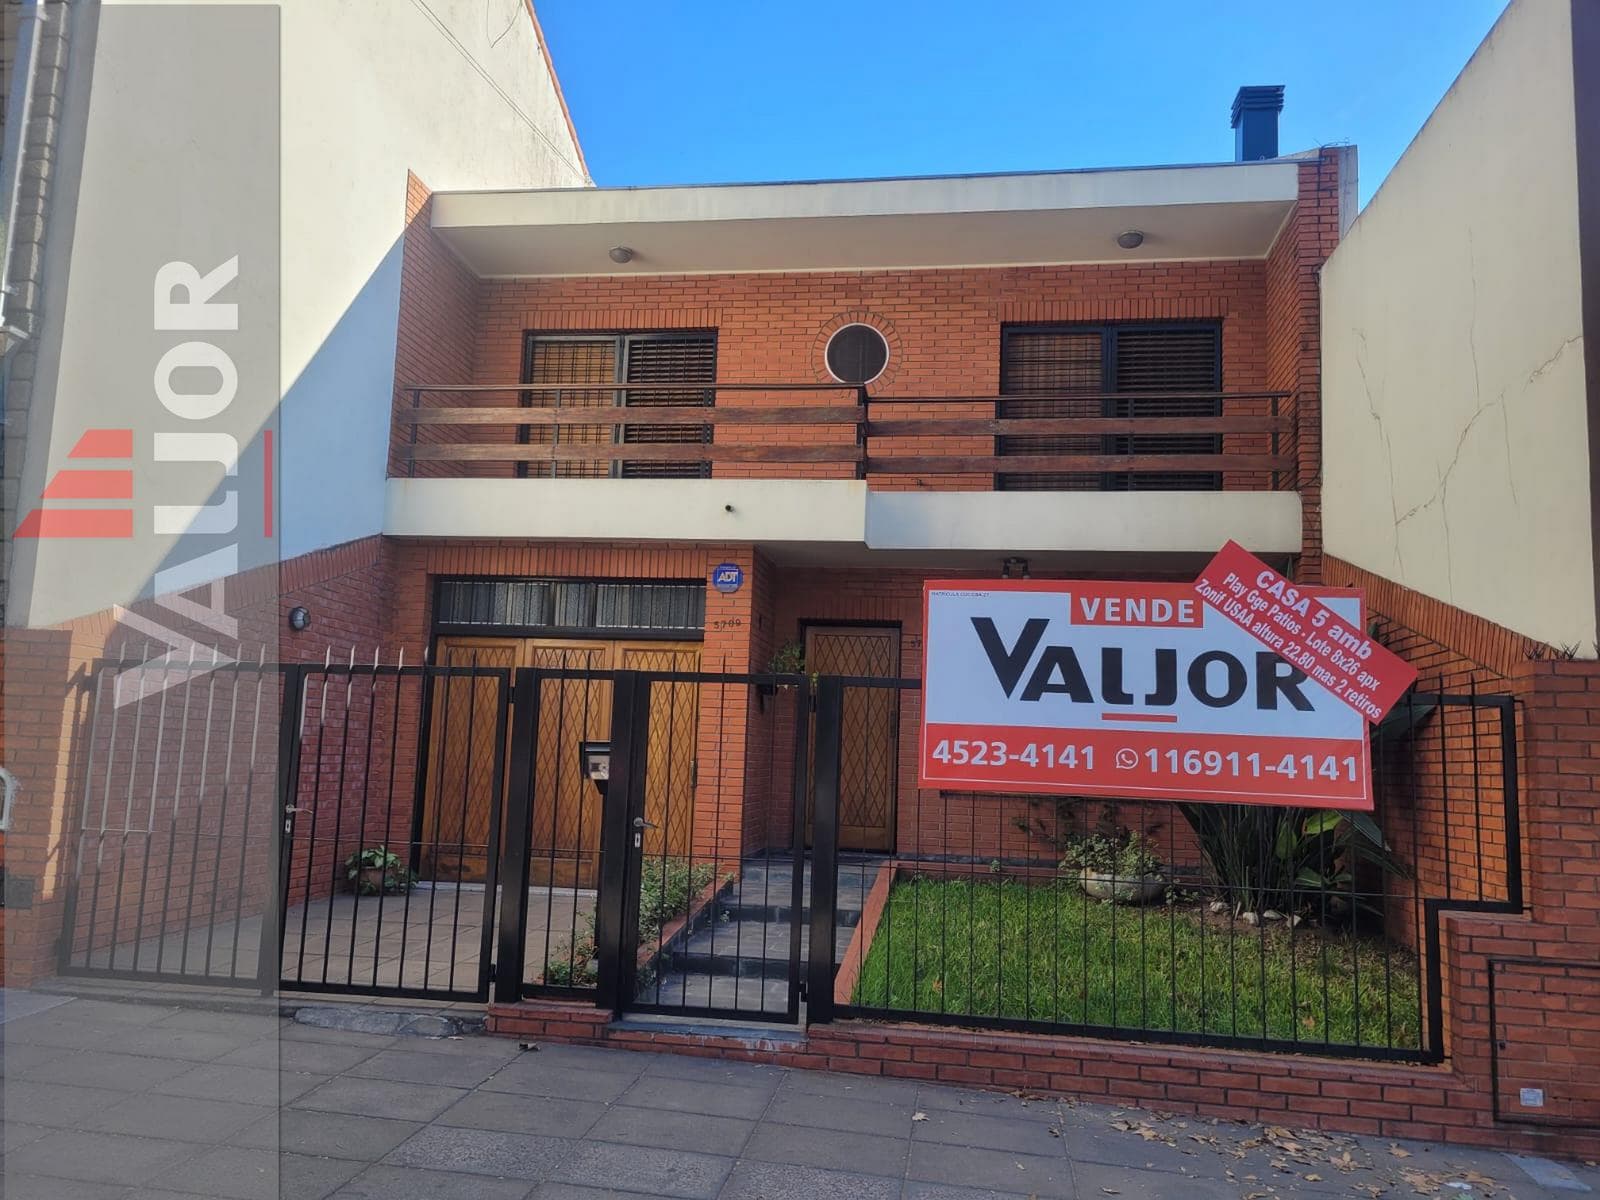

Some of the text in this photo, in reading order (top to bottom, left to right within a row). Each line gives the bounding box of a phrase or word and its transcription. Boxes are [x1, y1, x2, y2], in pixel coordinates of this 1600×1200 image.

[717, 571, 739, 583] ADT
[1080, 597, 1195, 623] VENDE
[1256, 570, 1373, 660] CASA 5 amb
[970, 616, 1316, 712] VALJOR
[1195, 579, 1382, 719] Zonif USAA altura 22.80 mas 2 retiros
[1222, 572, 1247, 598] Play
[1247, 589, 1268, 612] Gge
[1266, 604, 1300, 636] Patios
[1305, 631, 1331, 656] Lote
[1330, 649, 1358, 676] 8x26
[1358, 670, 1381, 691] apx
[932, 739, 1358, 782] 4523-4141 116911-4141
